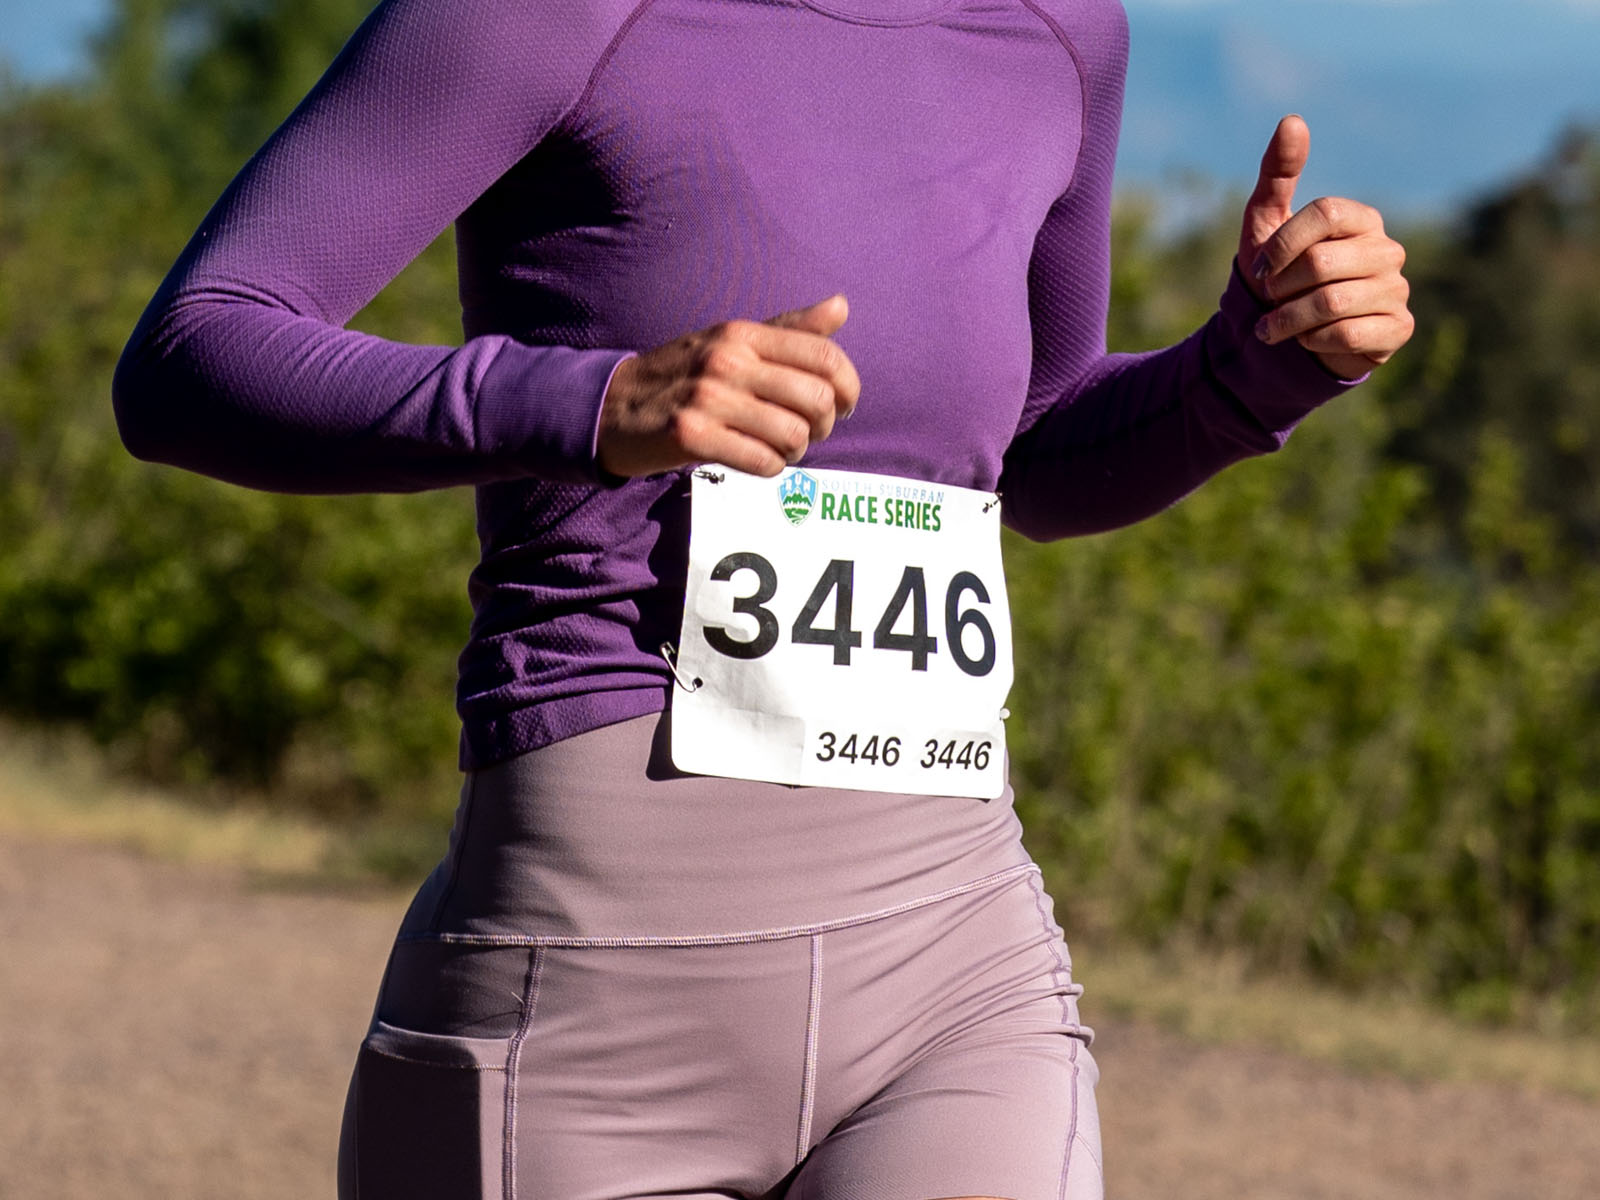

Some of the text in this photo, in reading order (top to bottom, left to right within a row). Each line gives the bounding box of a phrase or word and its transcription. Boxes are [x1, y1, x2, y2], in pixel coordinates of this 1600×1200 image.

[822, 479, 945, 503] SOUTH SUBURBAN
[821, 493, 941, 532] RACE SERIES
[703, 551, 997, 677] 3446
[816, 731, 992, 771] 3446 3446
